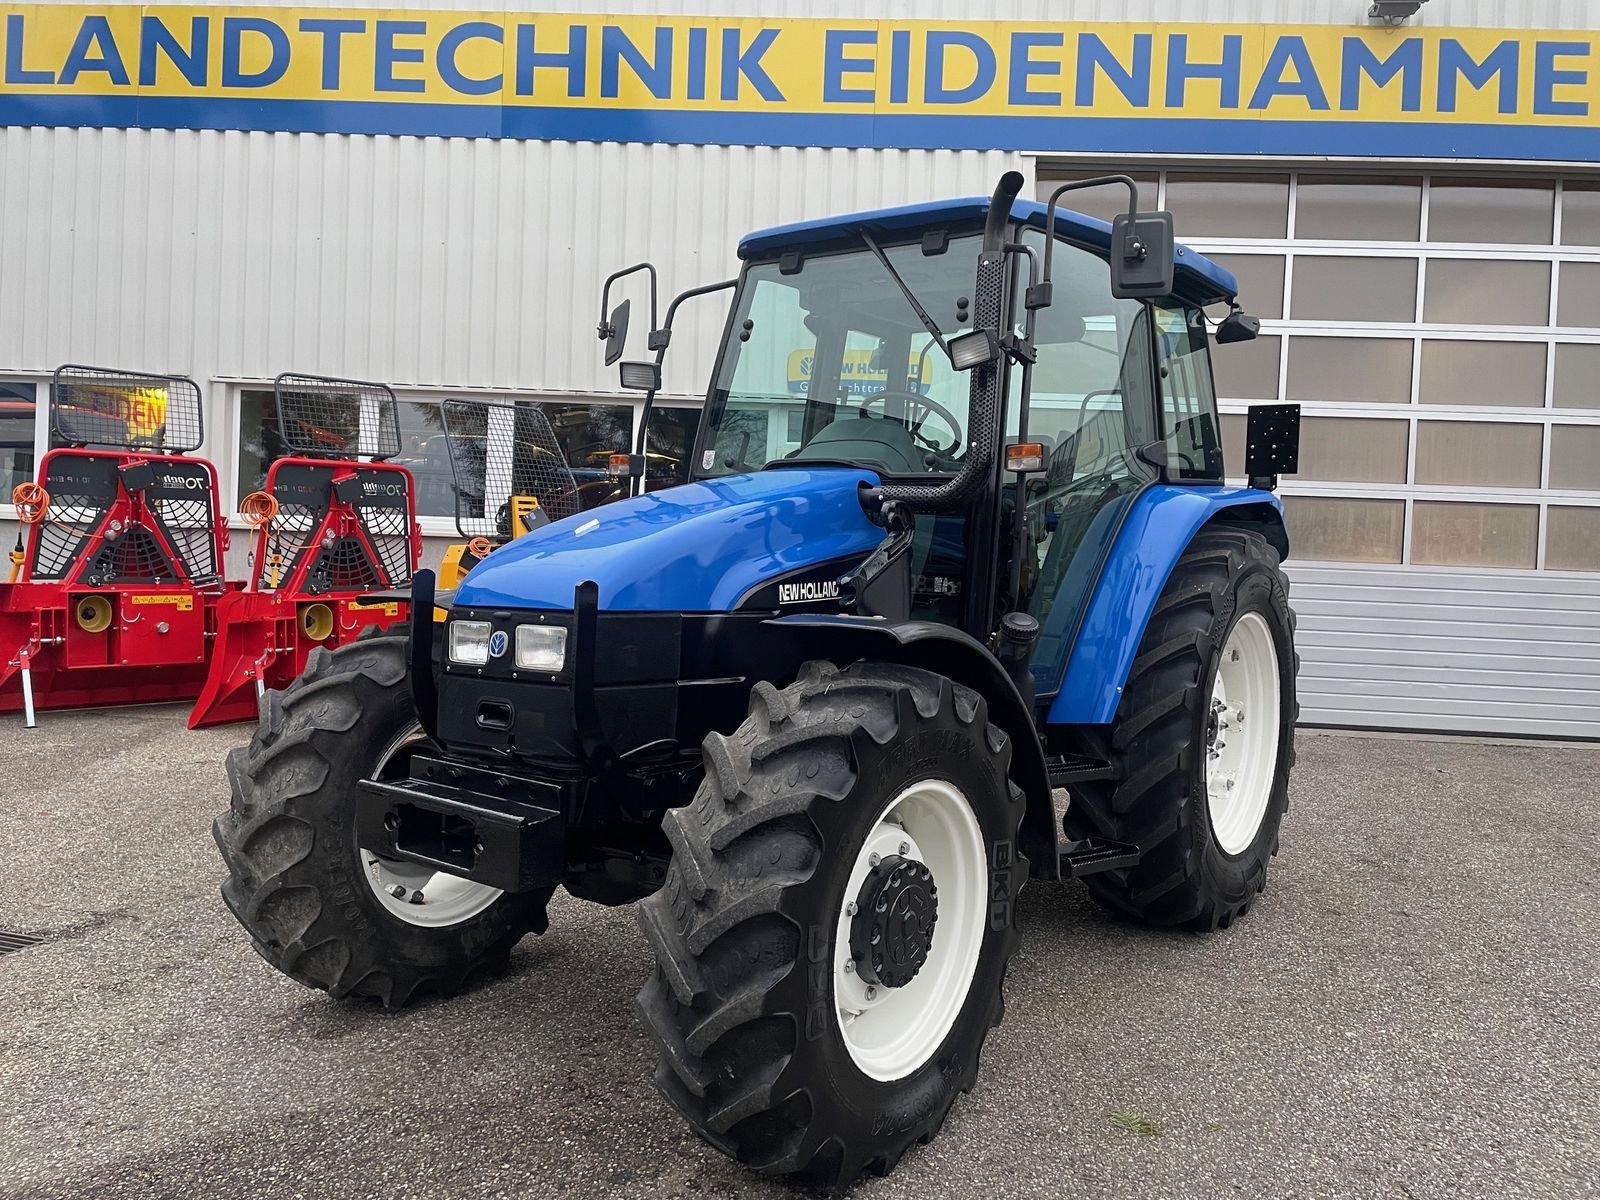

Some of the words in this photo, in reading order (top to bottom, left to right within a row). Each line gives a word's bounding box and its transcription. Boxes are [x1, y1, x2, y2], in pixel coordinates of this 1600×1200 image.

[4, 14, 787, 103] LANDTECHNIK
[823, 29, 1590, 116] EIDENHAMME
[779, 583, 799, 601] NEW
[800, 581, 839, 599] HOLLAND
[990, 840, 1012, 930] BKT
